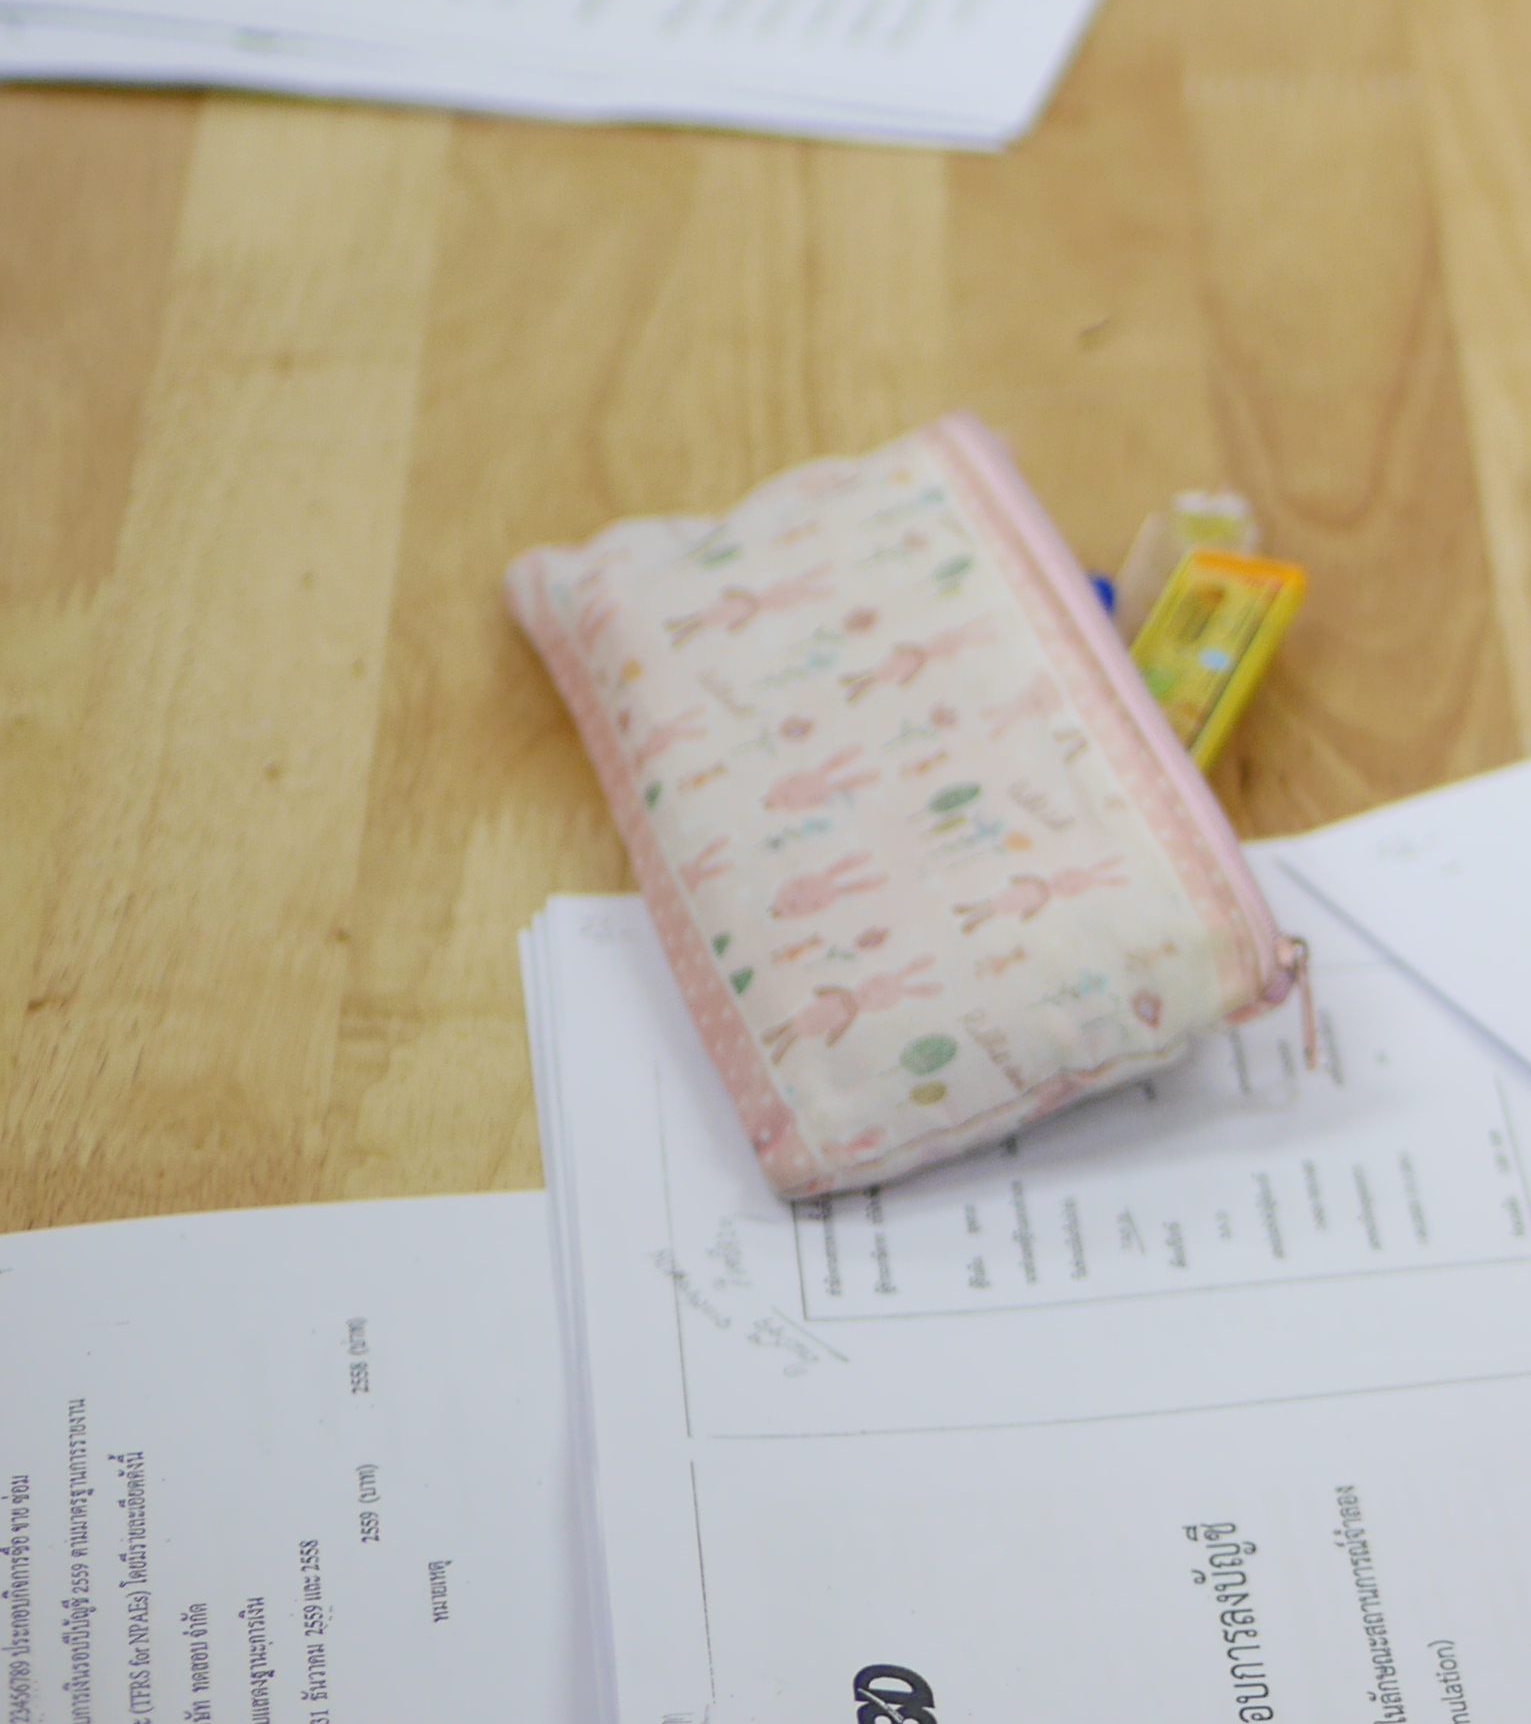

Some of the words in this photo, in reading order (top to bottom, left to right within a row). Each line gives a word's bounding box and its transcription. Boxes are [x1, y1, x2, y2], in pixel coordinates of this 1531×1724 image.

[349, 1361, 370, 1394] 2558
[1, 1475, 30, 1503] ซ่อม
[356, 1464, 380, 1503] (บาท)
[9, 1508, 29, 1531] ขาย
[360, 1512, 380, 1543] 2559
[299, 1540, 320, 1572] 2558
[71, 1563, 90, 1593] 2559
[427, 1560, 452, 1623] หมายเหตุ
[126, 1591, 150, 1644] NPAEs)
[181, 1602, 208, 1638] จำกัด
[303, 1605, 324, 1636] 2559
[131, 1647, 150, 1665] for
[188, 1642, 211, 1692] ทดสอบ
[301, 1644, 328, 1701] ธันวาคม
[129, 1670, 154, 1714] (TFRS
